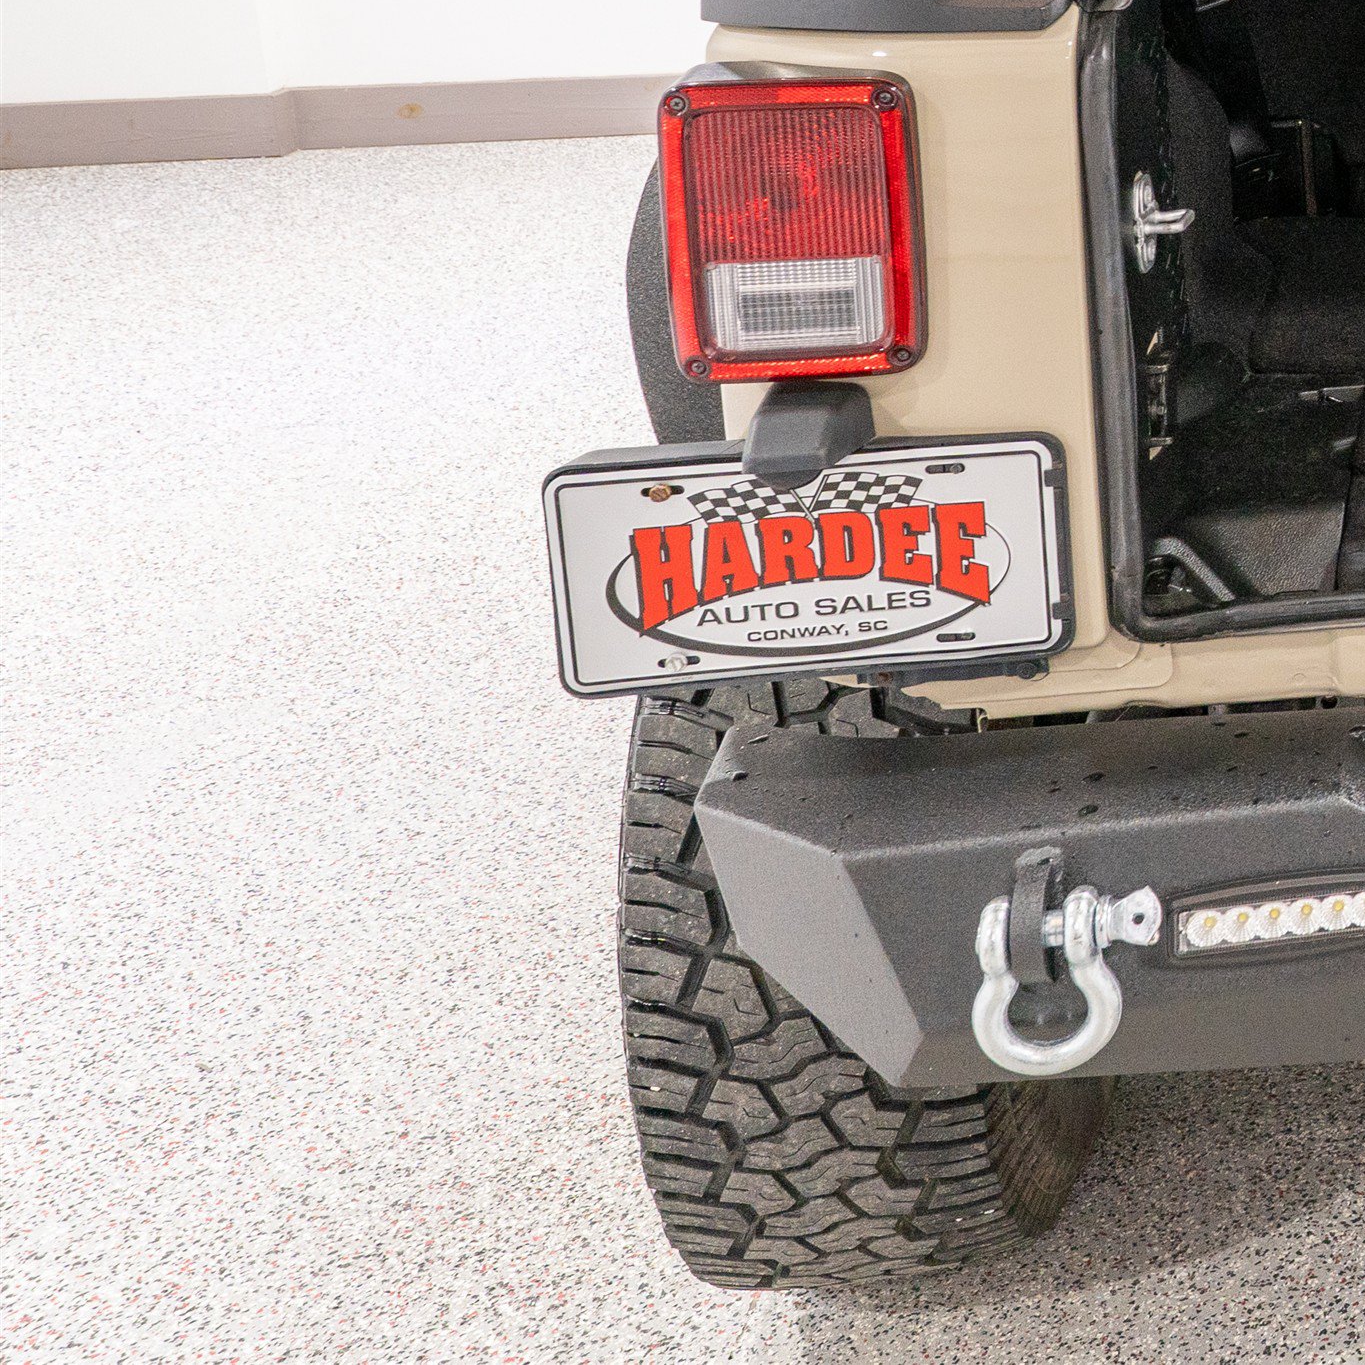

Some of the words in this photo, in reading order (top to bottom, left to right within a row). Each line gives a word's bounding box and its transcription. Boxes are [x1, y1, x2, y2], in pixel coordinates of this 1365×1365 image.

[630, 501, 991, 637] HARDEE
[697, 601, 799, 627] AUTO
[815, 589, 932, 615] SALES
[747, 622, 850, 642] CONWAY,
[858, 619, 888, 633] SC
